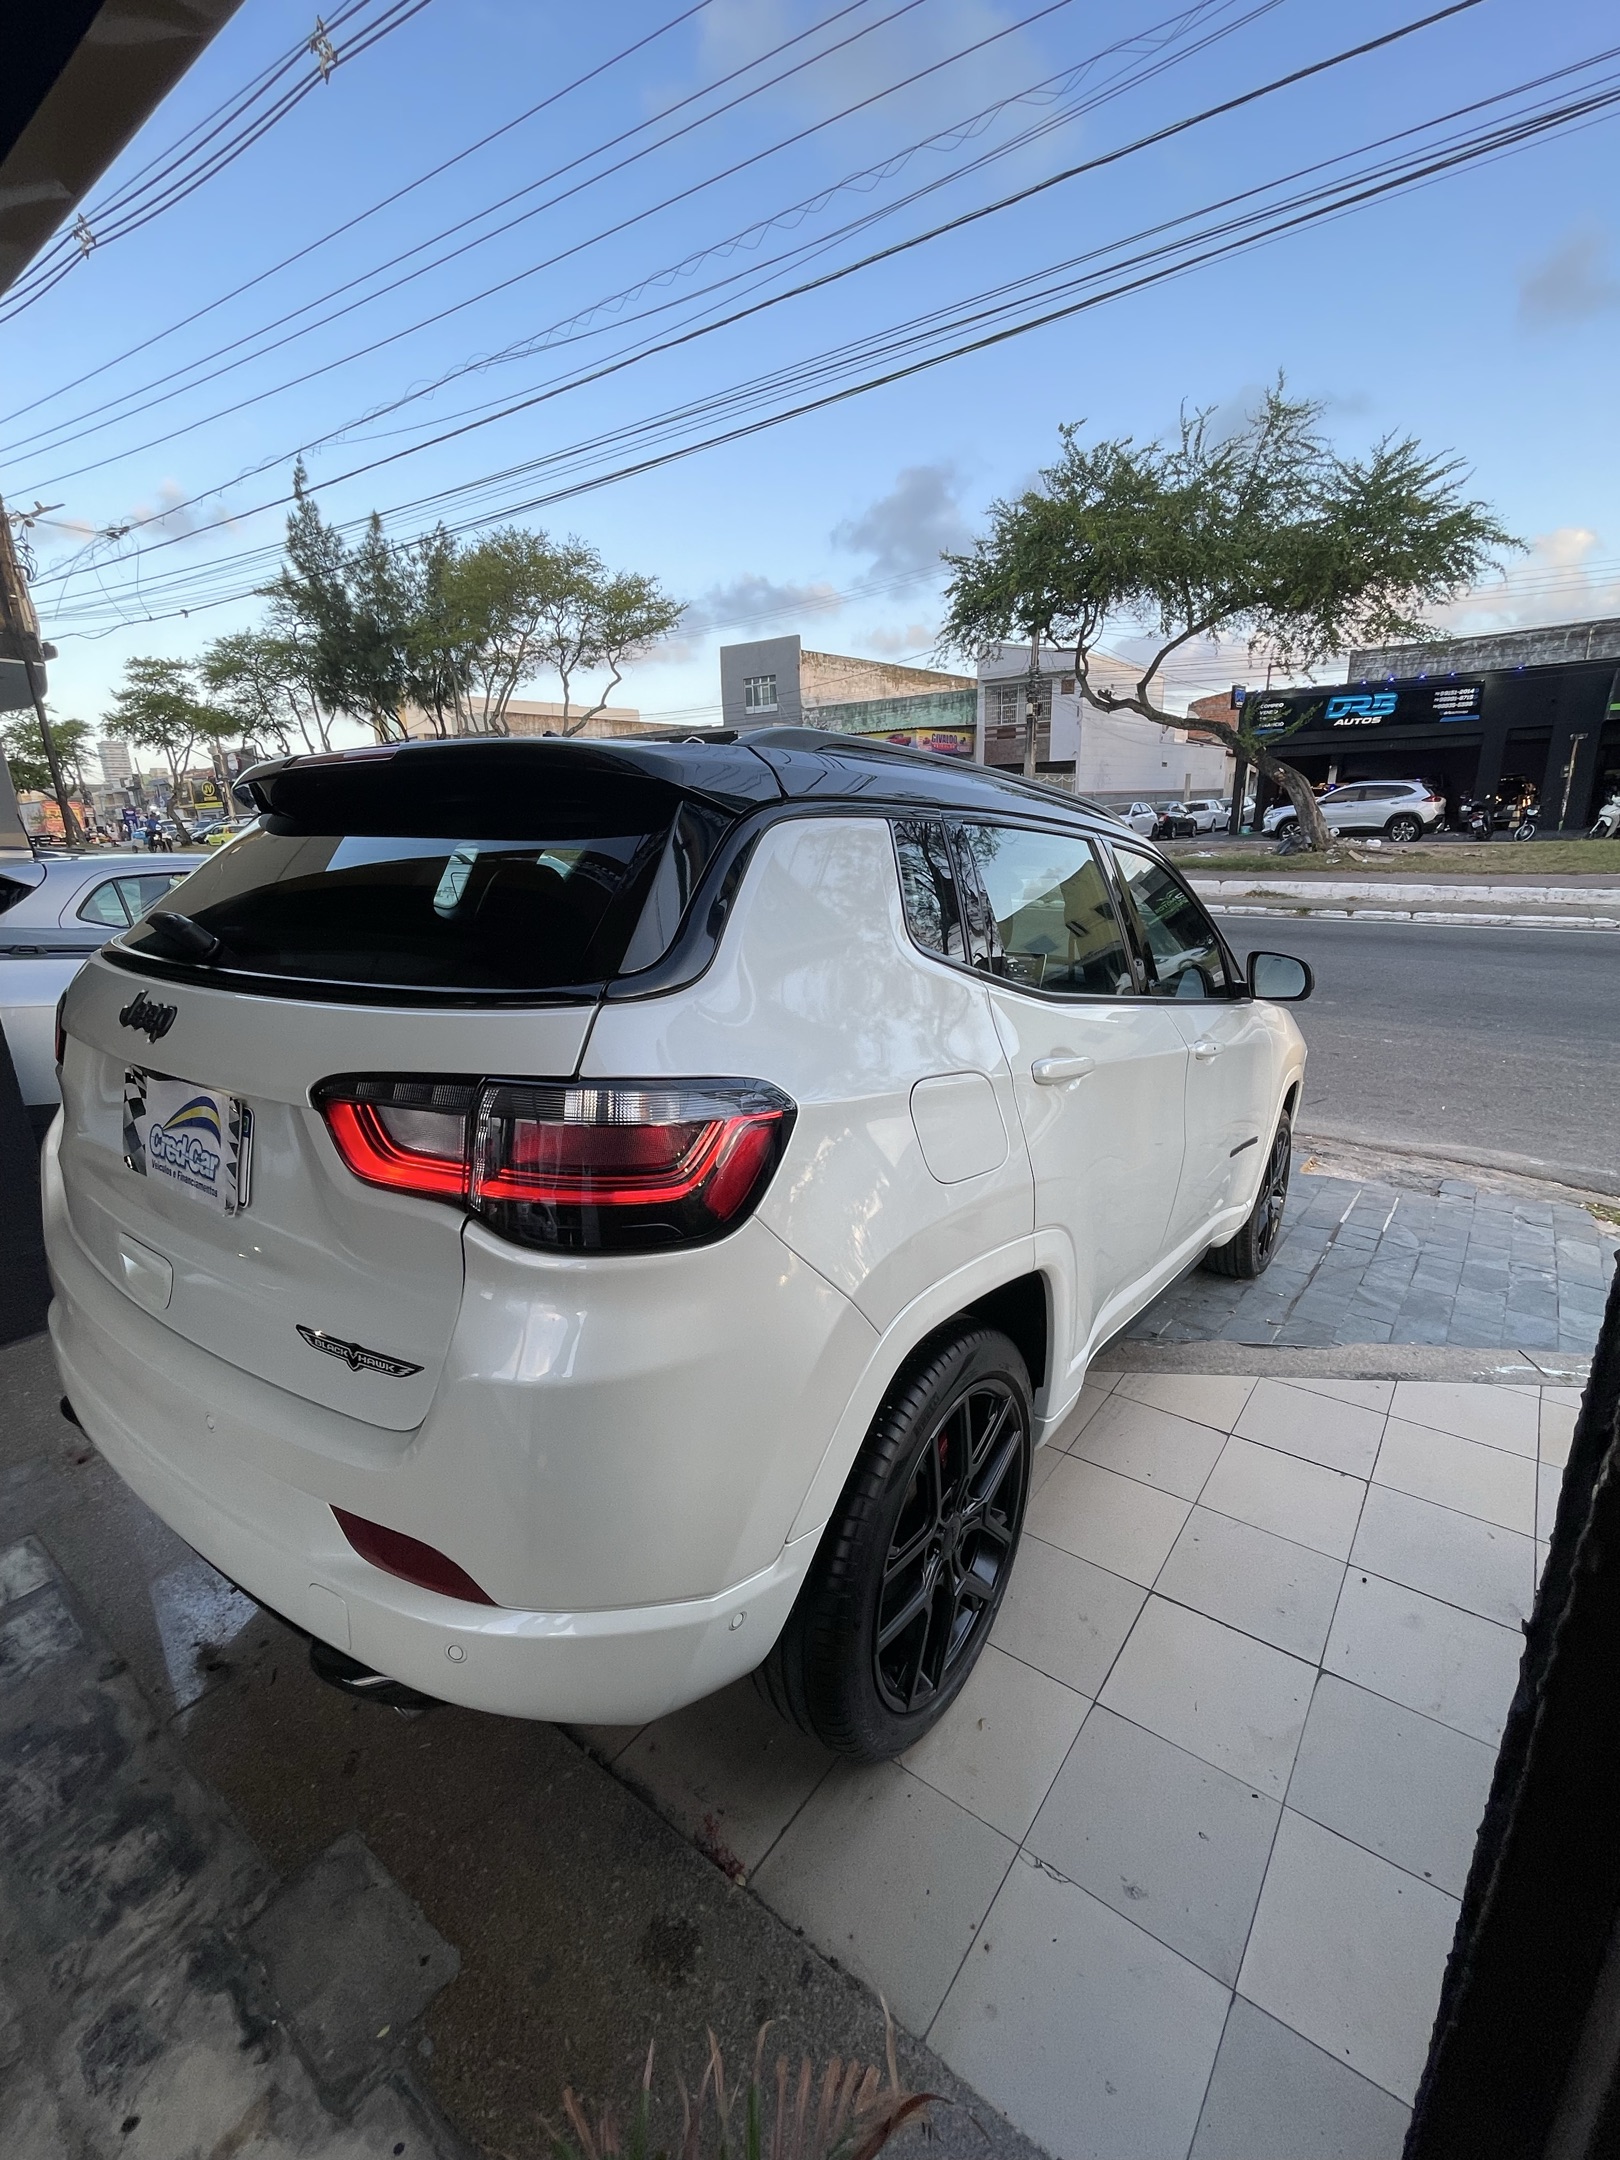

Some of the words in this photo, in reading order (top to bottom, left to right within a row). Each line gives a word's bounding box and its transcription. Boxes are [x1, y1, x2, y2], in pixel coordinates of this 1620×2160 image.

[1324, 692, 1398, 719] DRB
[1334, 716, 1382, 726] AUTOS
[932, 733, 957, 744] GIVALDO
[177, 1170, 218, 1198] Financiamentos
[314, 1339, 349, 1357] BLACK
[358, 1355, 395, 1373] HAWK
